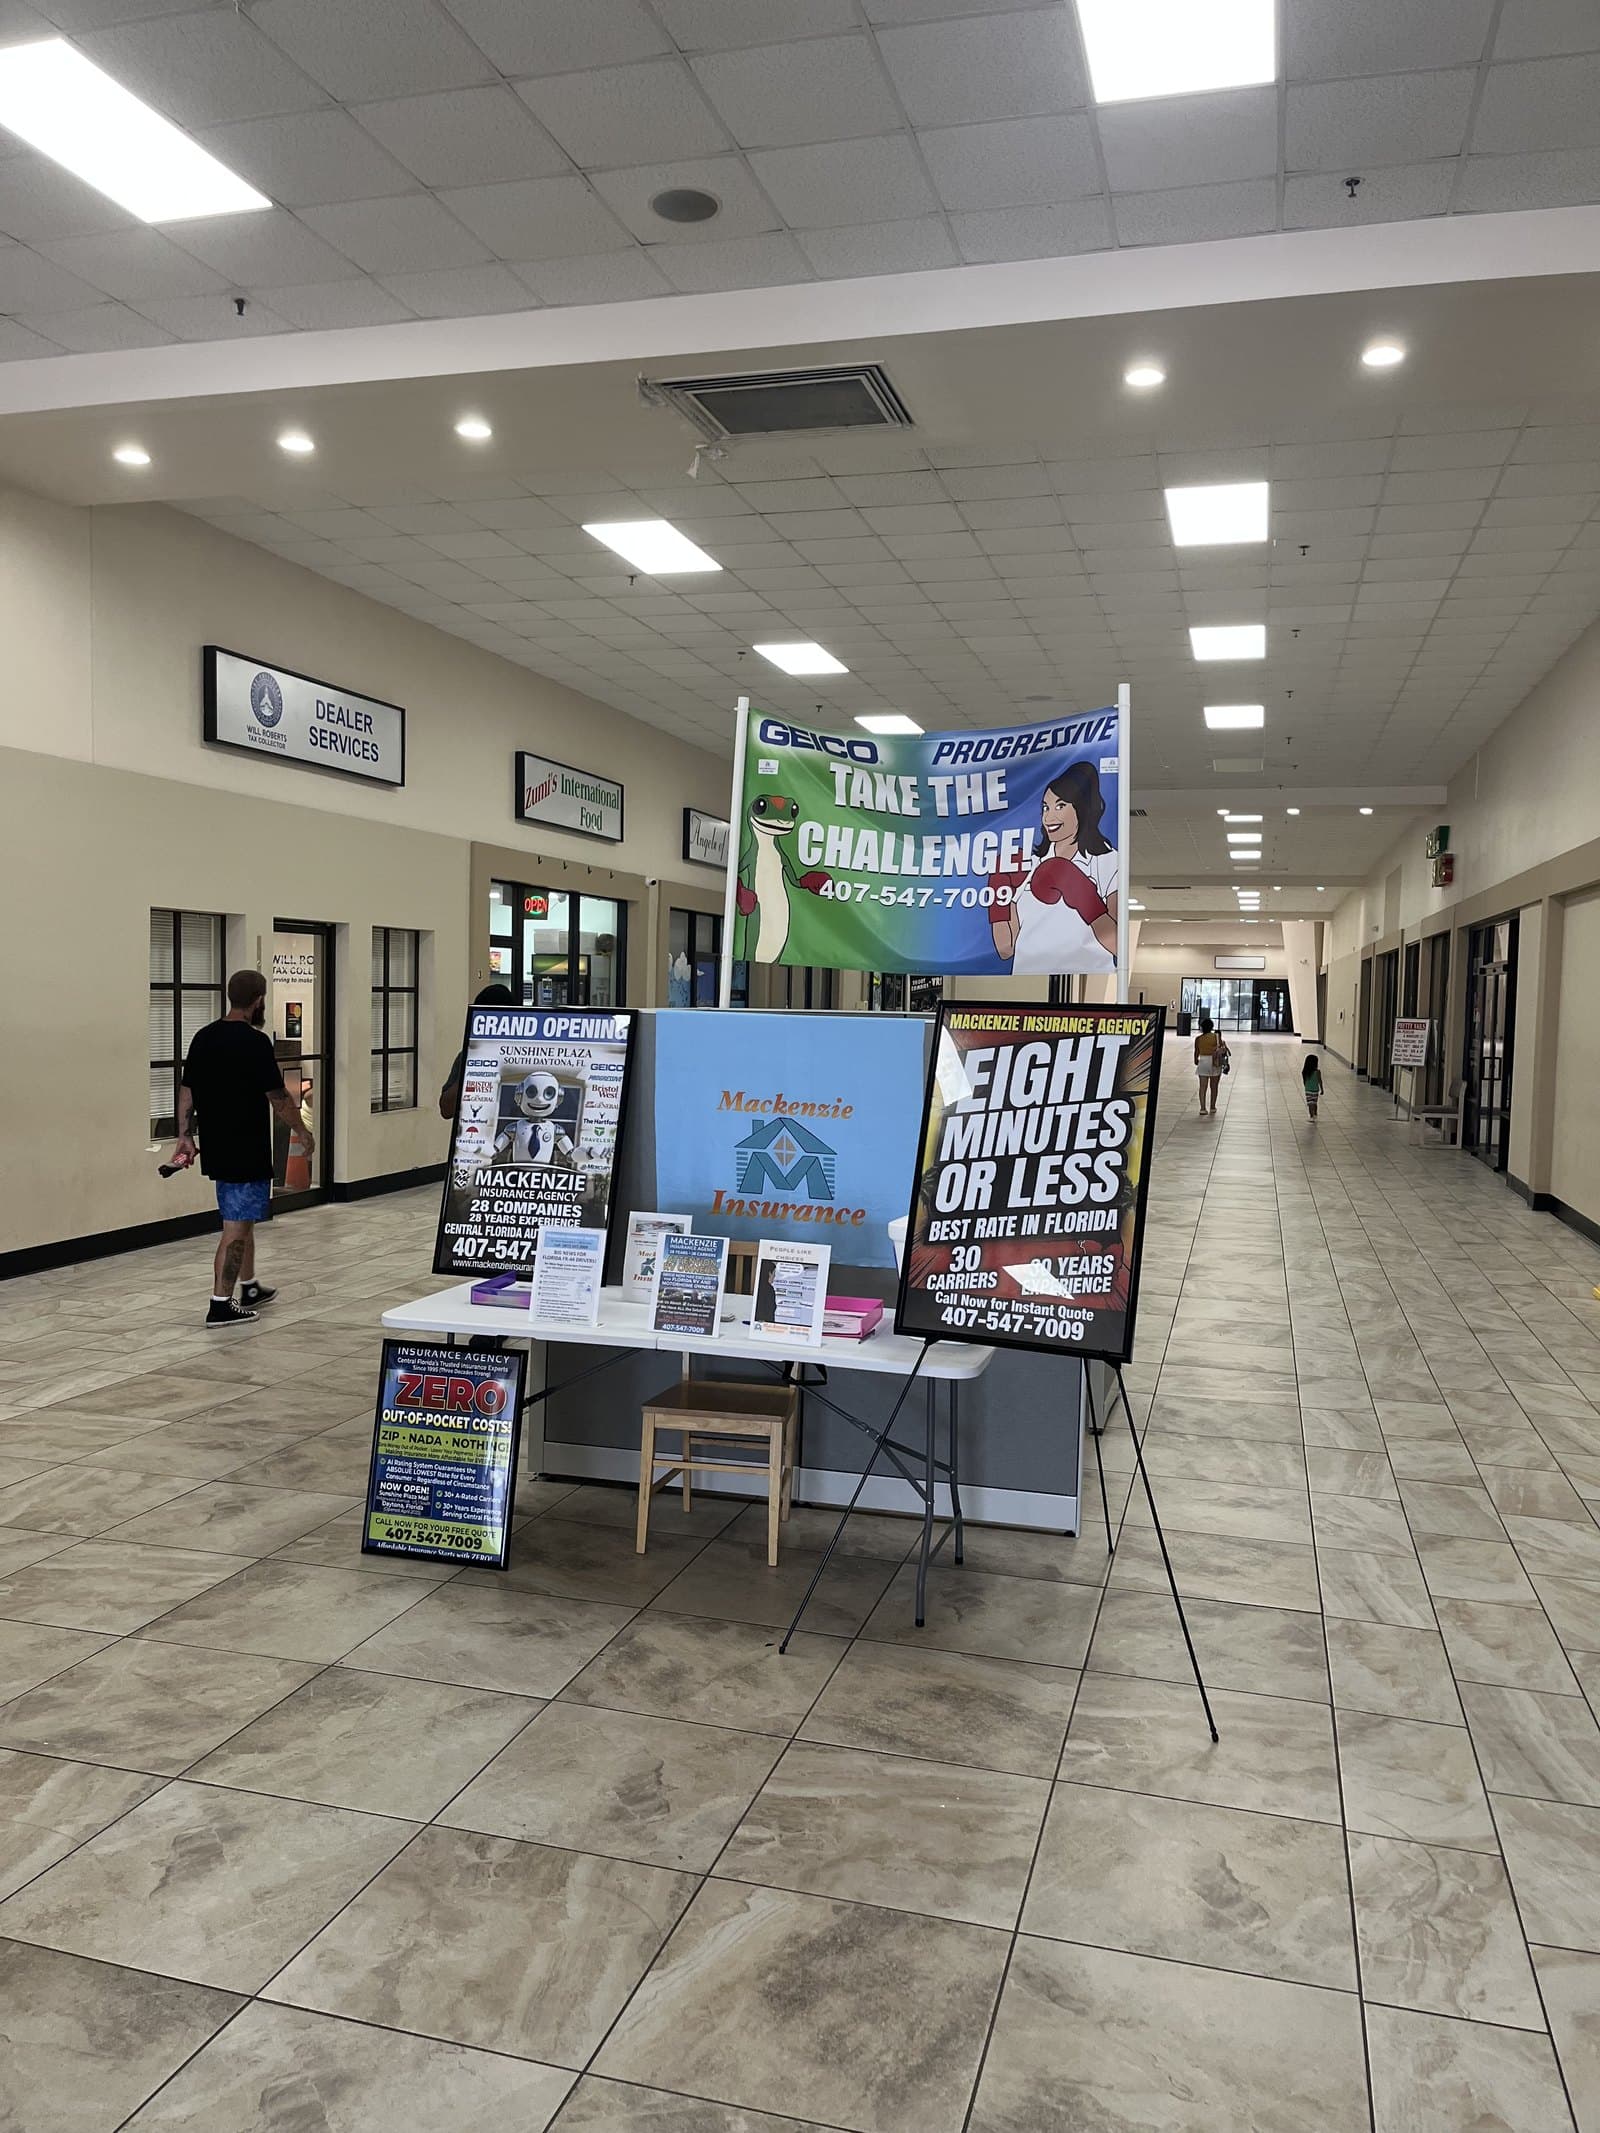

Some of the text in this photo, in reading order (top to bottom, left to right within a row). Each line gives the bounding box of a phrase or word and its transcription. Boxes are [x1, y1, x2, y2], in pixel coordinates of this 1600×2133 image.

[316, 699, 373, 735] DEALER
[246, 724, 287, 743] WILL ROBERTS
[248, 734, 286, 750] TAX COLLECTOR
[759, 718, 881, 765] GEICO
[931, 716, 1118, 766] PROGRESSIVE
[309, 725, 379, 763] SERVICES
[525, 773, 620, 810] Zumi's International
[829, 762, 1010, 818] TAKE THE
[580, 806, 603, 832] Food
[798, 820, 1035, 877] CHALLENGE!
[819, 879, 1013, 908] 407-547-7009
[524, 897, 548, 912] OPEN
[472, 1015, 538, 1037] GRAND
[950, 1013, 1149, 1036] MACKENZIE INSURANCE AGENCY
[500, 1045, 592, 1059] SUNSHINE PLAZA
[504, 1056, 531, 1065] SOUTH
[533, 1058, 575, 1067] DAYTONA,
[466, 1059, 498, 1067] GEICO
[590, 1064, 624, 1072] GEICO
[956, 1035, 1130, 1114] EIGHT
[592, 1084, 619, 1092] Bristol
[716, 1090, 854, 1120] Mackenzie
[940, 1099, 1130, 1162] MINUTES
[475, 1170, 587, 1191] MACKENZIE
[935, 1150, 1123, 1213] OR LESS
[480, 1187, 578, 1201] INSURANCE AGENCY
[470, 1200, 582, 1217] 28 COMPANIES
[708, 1190, 866, 1226] Insurance
[444, 1223, 522, 1238] CENTRAL FLORIDA
[469, 1213, 581, 1228] 28 YEARS EXPERIENCE
[928, 1208, 1118, 1242] BEST RATE IN FLORIDA
[670, 1237, 718, 1248] MACKENZIE
[770, 1246, 795, 1254] PEOPLE
[949, 1245, 982, 1273] 30
[1057, 1254, 1115, 1276] YEARS
[926, 1272, 998, 1290] CARRIERS
[935, 1291, 1094, 1321] Call Now for Instant Quote
[941, 1307, 1085, 1341] 407-547-7009
[398, 1347, 510, 1364] INSURANCE AGENCY
[461, 1362, 487, 1370] Insurance
[487, 1365, 508, 1373] Experts
[395, 1373, 507, 1415] ZERO
[382, 1409, 512, 1434] OUT-OF-POCKET COSTS!
[381, 1430, 399, 1441] ZIP
[408, 1433, 442, 1445] NADA
[385, 1473, 412, 1481] Consumer
[394, 1460, 412, 1468] Rating
[413, 1461, 433, 1470] System
[434, 1464, 466, 1474] Guarantees
[413, 1468, 437, 1477] LOWEST
[437, 1470, 450, 1478] Rate
[451, 1471, 459, 1479] for
[459, 1473, 475, 1482] Every
[380, 1481, 430, 1495] NOW OPEN!
[442, 1510, 462, 1519] Serving
[463, 1512, 483, 1521] Central
[454, 1504, 470, 1513] Years
[375, 1517, 393, 1526] CALL
[394, 1519, 412, 1528] NOW
[413, 1521, 429, 1530] FOR
[430, 1523, 450, 1533] YOUR
[451, 1526, 470, 1535] FREE
[385, 1527, 483, 1550] 407-547-7009
